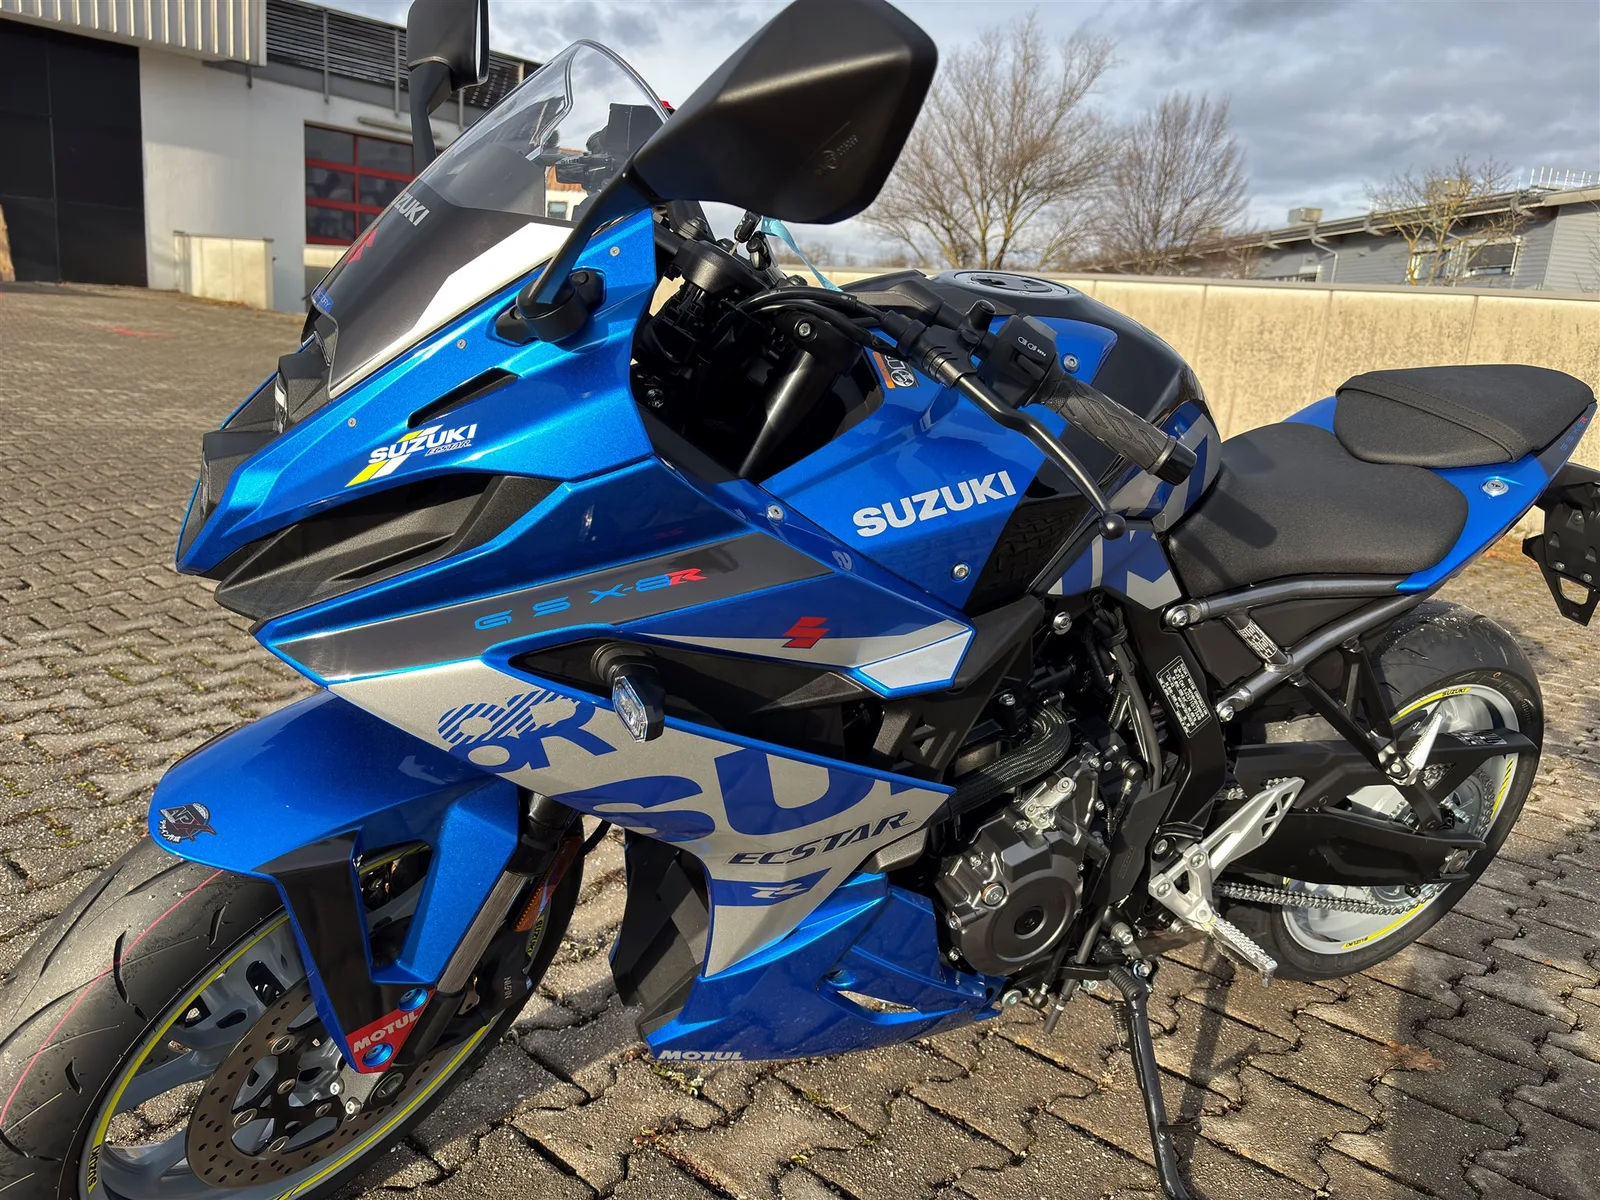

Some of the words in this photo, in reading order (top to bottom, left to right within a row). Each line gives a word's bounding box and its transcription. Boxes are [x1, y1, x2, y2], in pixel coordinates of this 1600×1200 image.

[368, 424, 478, 463] SUZUKI
[852, 470, 1017, 537] SUZUKI
[727, 810, 916, 865] ECSTAR
[353, 1011, 419, 1053] MOTUL
[658, 1049, 744, 1061] MOTUL
[87, 1144, 101, 1187] SUZUKI
